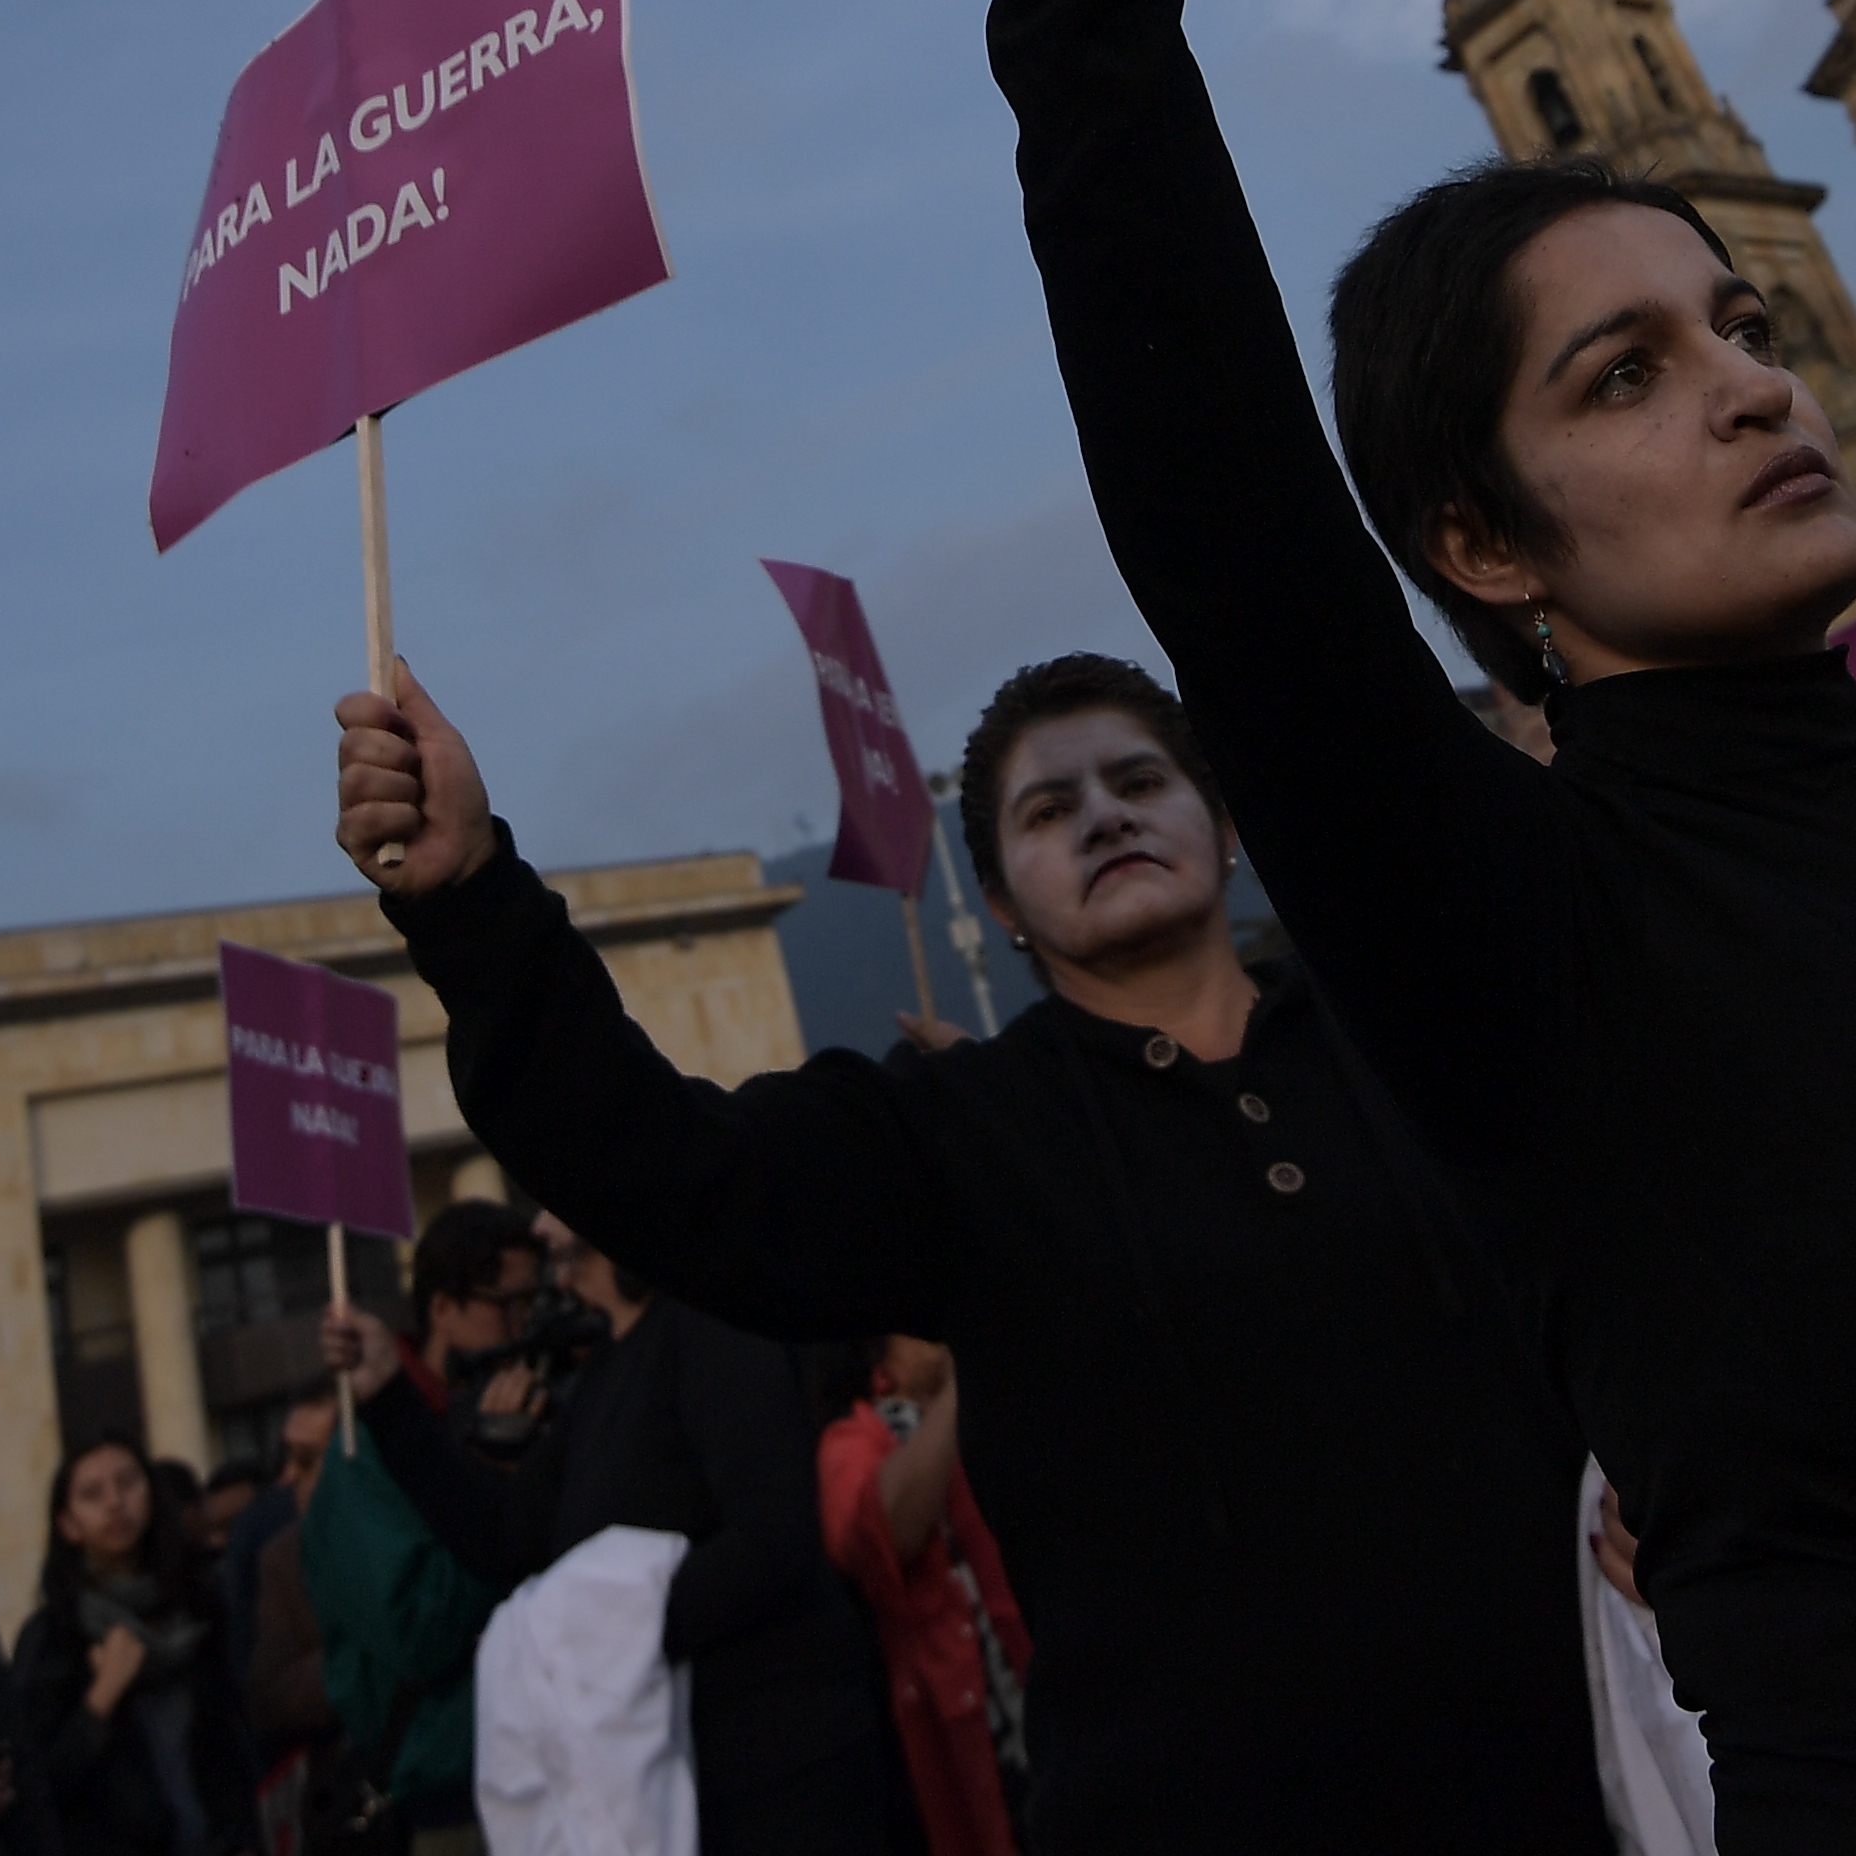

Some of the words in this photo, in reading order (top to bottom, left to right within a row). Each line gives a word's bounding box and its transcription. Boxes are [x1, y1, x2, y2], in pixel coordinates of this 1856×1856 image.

[286, 133, 340, 208] LA
[279, 168, 449, 314] NADA!
[290, 1042, 326, 1075] LA
